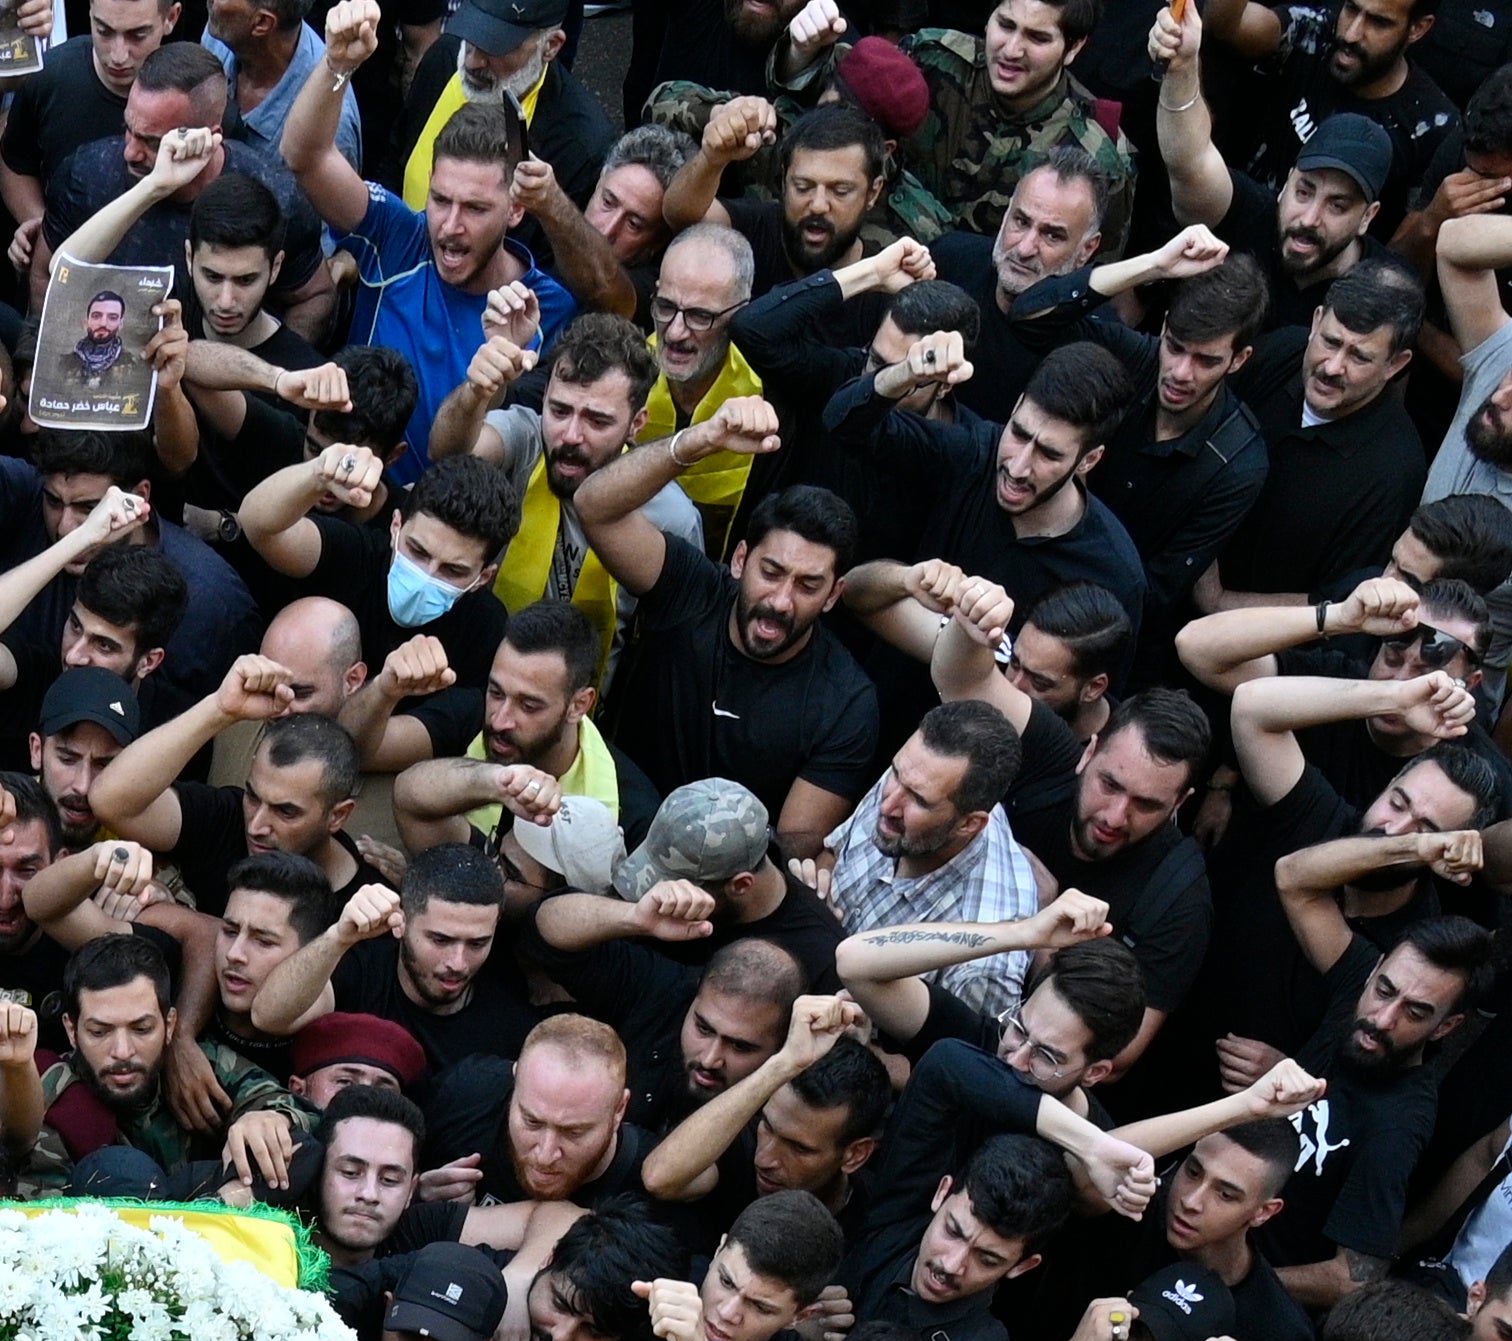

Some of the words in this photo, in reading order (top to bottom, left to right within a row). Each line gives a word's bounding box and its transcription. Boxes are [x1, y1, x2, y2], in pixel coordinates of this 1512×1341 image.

[39, 397, 70, 411] حمادة
[92, 400, 121, 415] عباس
[1161, 1289, 1193, 1315] adidas
